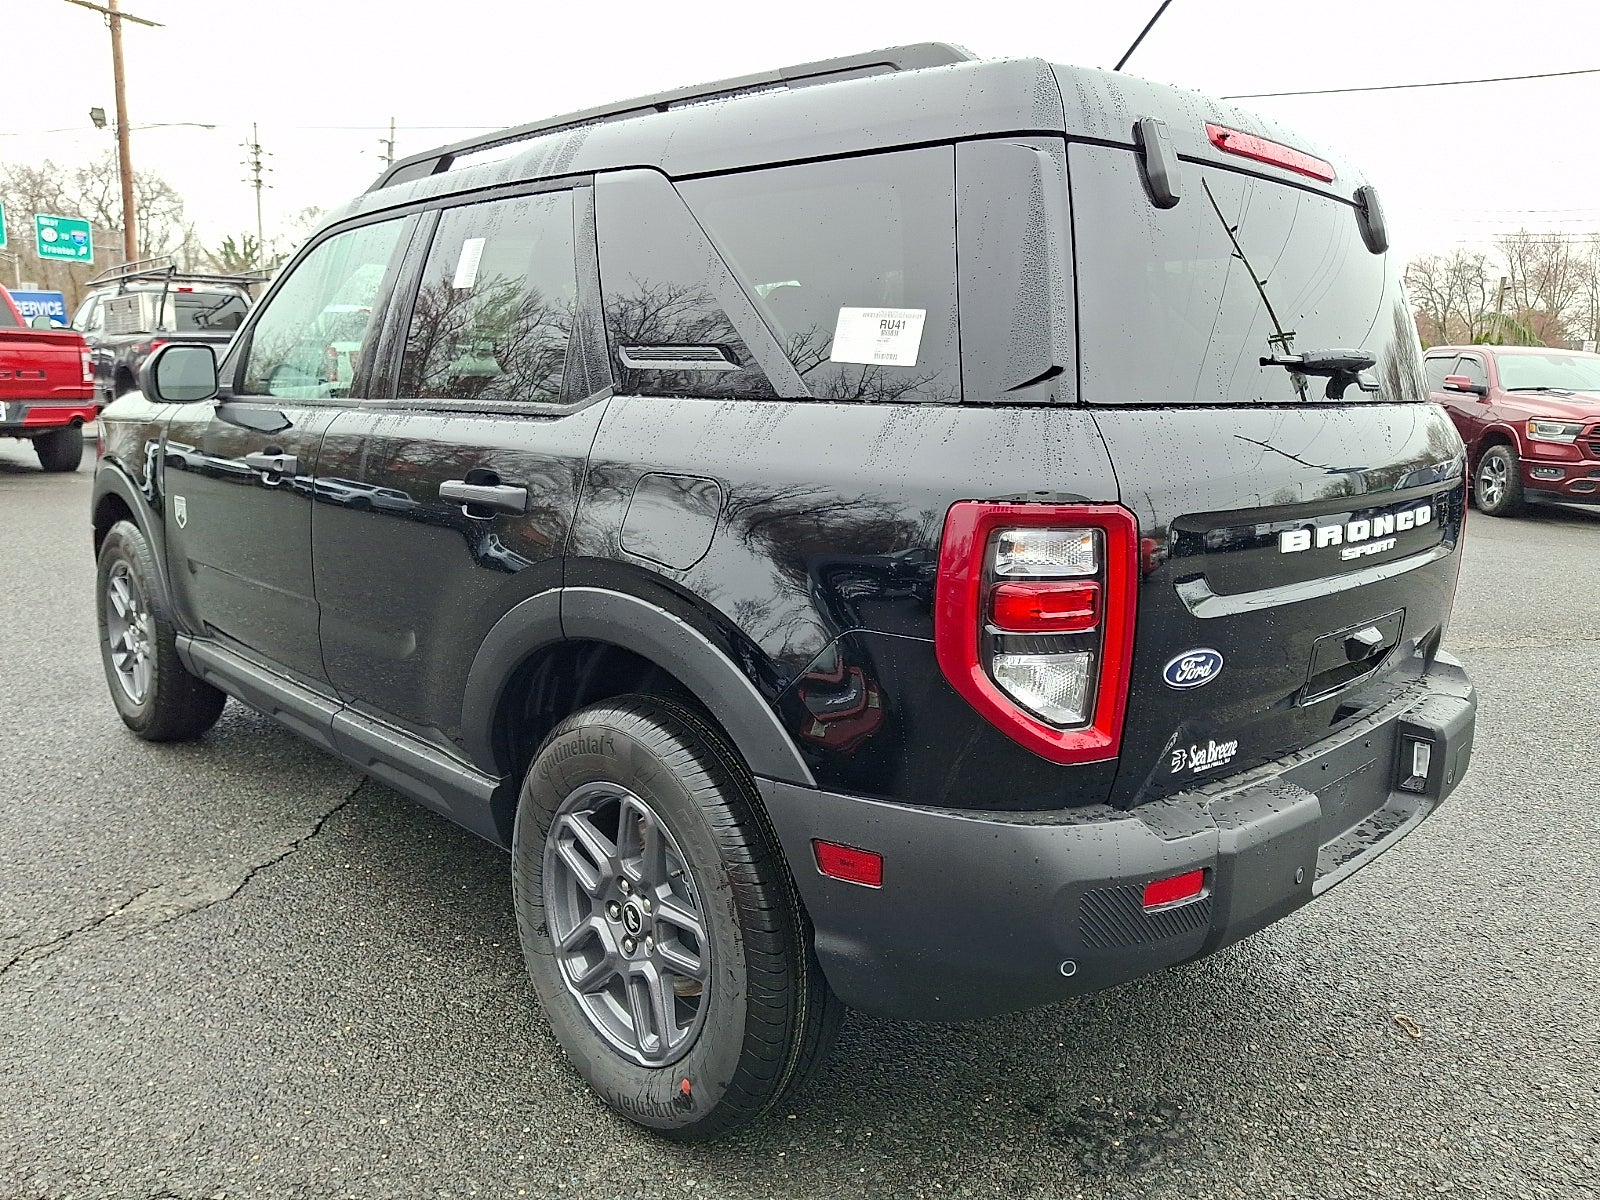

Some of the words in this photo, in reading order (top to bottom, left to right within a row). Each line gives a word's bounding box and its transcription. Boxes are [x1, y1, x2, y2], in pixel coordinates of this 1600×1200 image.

[41, 244, 76, 256] Trenton
[15, 301, 64, 316] SERVICE
[879, 319, 906, 330] RU41
[1279, 505, 1432, 553] BRONCO
[1340, 538, 1397, 561] SPORT
[1176, 655, 1214, 682] Ford
[1188, 744, 1207, 769] Sea
[1207, 740, 1238, 763] Breeze
